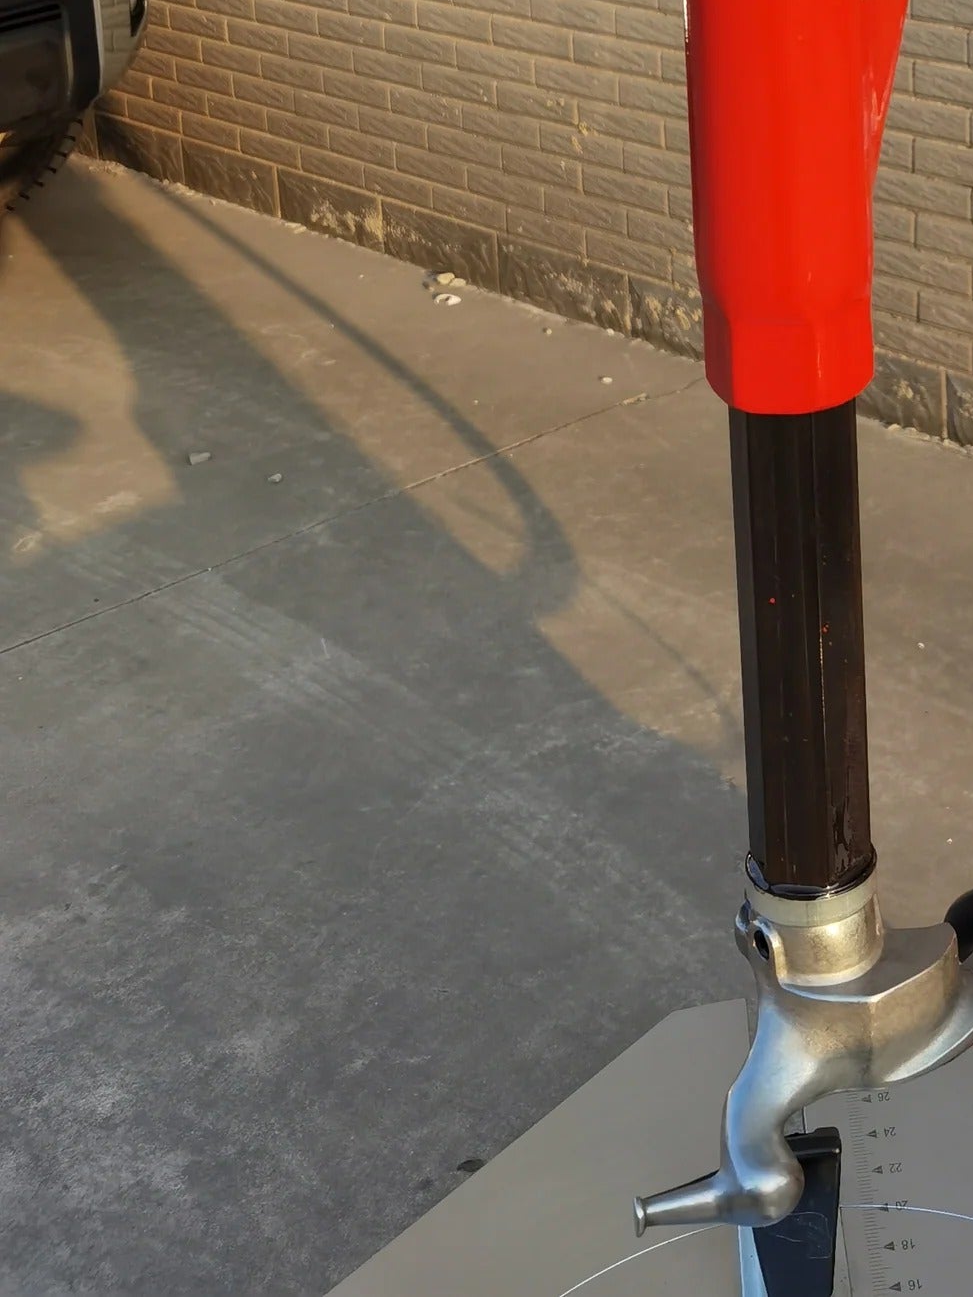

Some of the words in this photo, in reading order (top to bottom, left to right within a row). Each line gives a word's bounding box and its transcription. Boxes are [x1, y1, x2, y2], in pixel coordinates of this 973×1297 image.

[877, 1091, 890, 1102] 26
[883, 1126, 897, 1137] 24
[889, 1162, 902, 1173] 22
[901, 1238, 916, 1251] 18
[908, 1279, 923, 1291] 16
